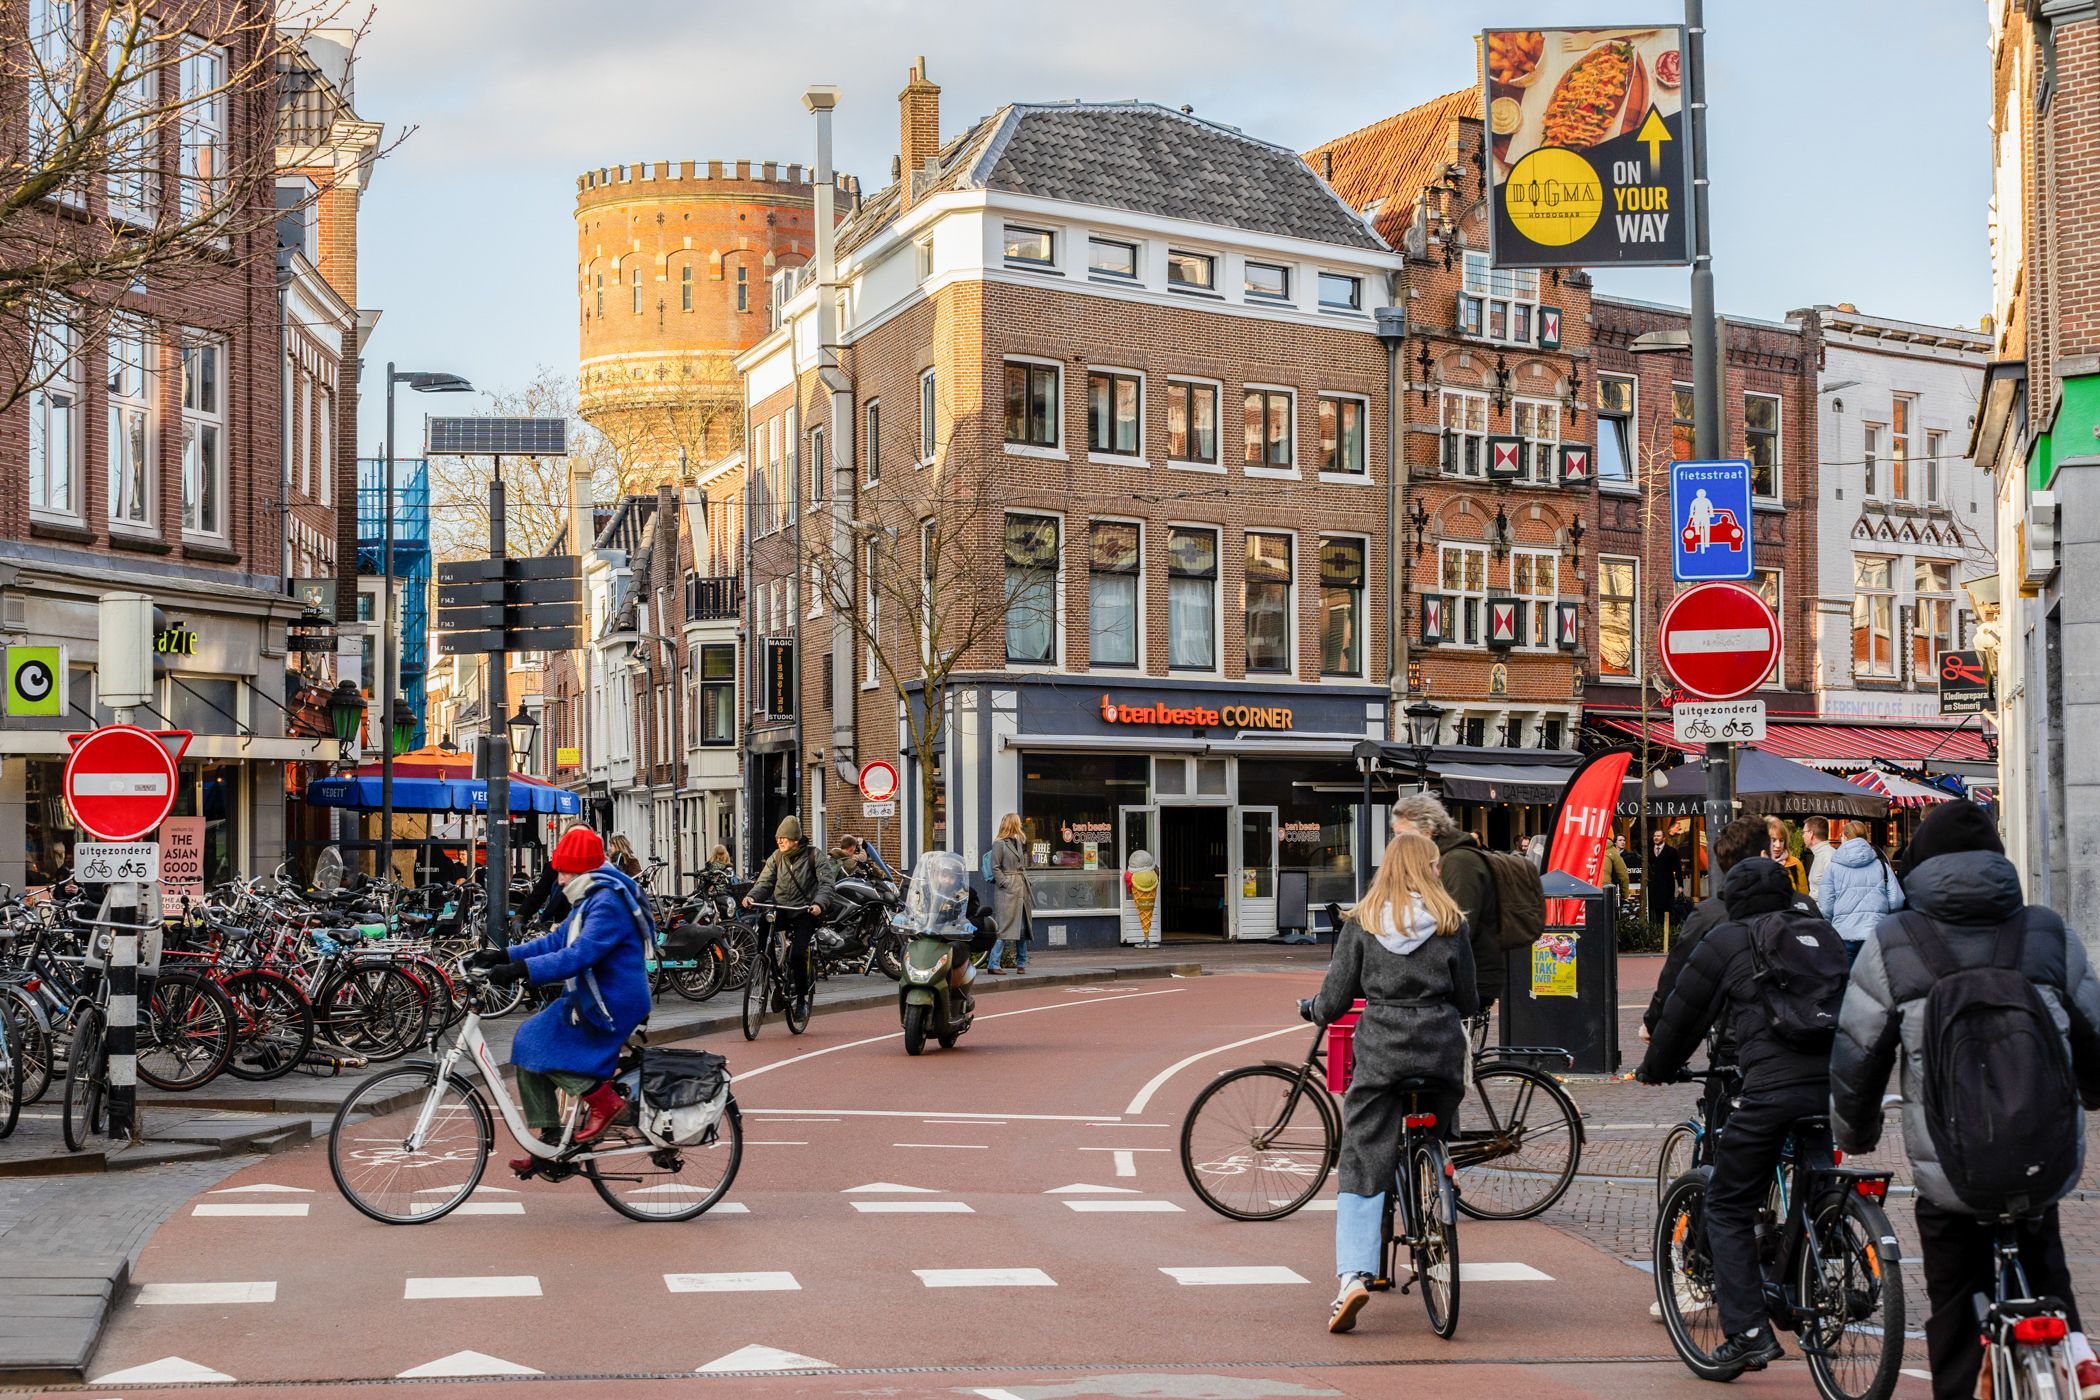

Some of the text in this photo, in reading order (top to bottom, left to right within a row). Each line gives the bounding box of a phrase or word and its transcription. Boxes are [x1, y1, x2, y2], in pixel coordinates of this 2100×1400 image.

[1614, 161, 1641, 184] ON
[1513, 179, 1595, 206] DOGMA
[1613, 187, 1669, 211] YOUR
[1616, 214, 1670, 243] WAY
[1680, 470, 1743, 480] fietsstraat
[1943, 692, 1996, 700] Kledingrepara
[1680, 704, 1758, 717] uitgezonderd
[1221, 705, 1293, 729] CORNER
[322, 788, 344, 797] VEDETT
[471, 791, 488, 801] VED
[1785, 798, 1845, 812] KOENRAAD
[172, 835, 192, 845] THE
[1073, 832, 1112, 843] CORNER
[1286, 831, 1320, 842] CORNER
[79, 847, 152, 857] uitgezonderd
[1033, 843, 1051, 853] BUBBLE
[164, 849, 198, 859] ASIAN
[163, 862, 198, 873] GOOD
[1535, 951, 1550, 961] TAP
[1535, 963, 1557, 974] TAKE
[1534, 975, 1551, 983] OVER
